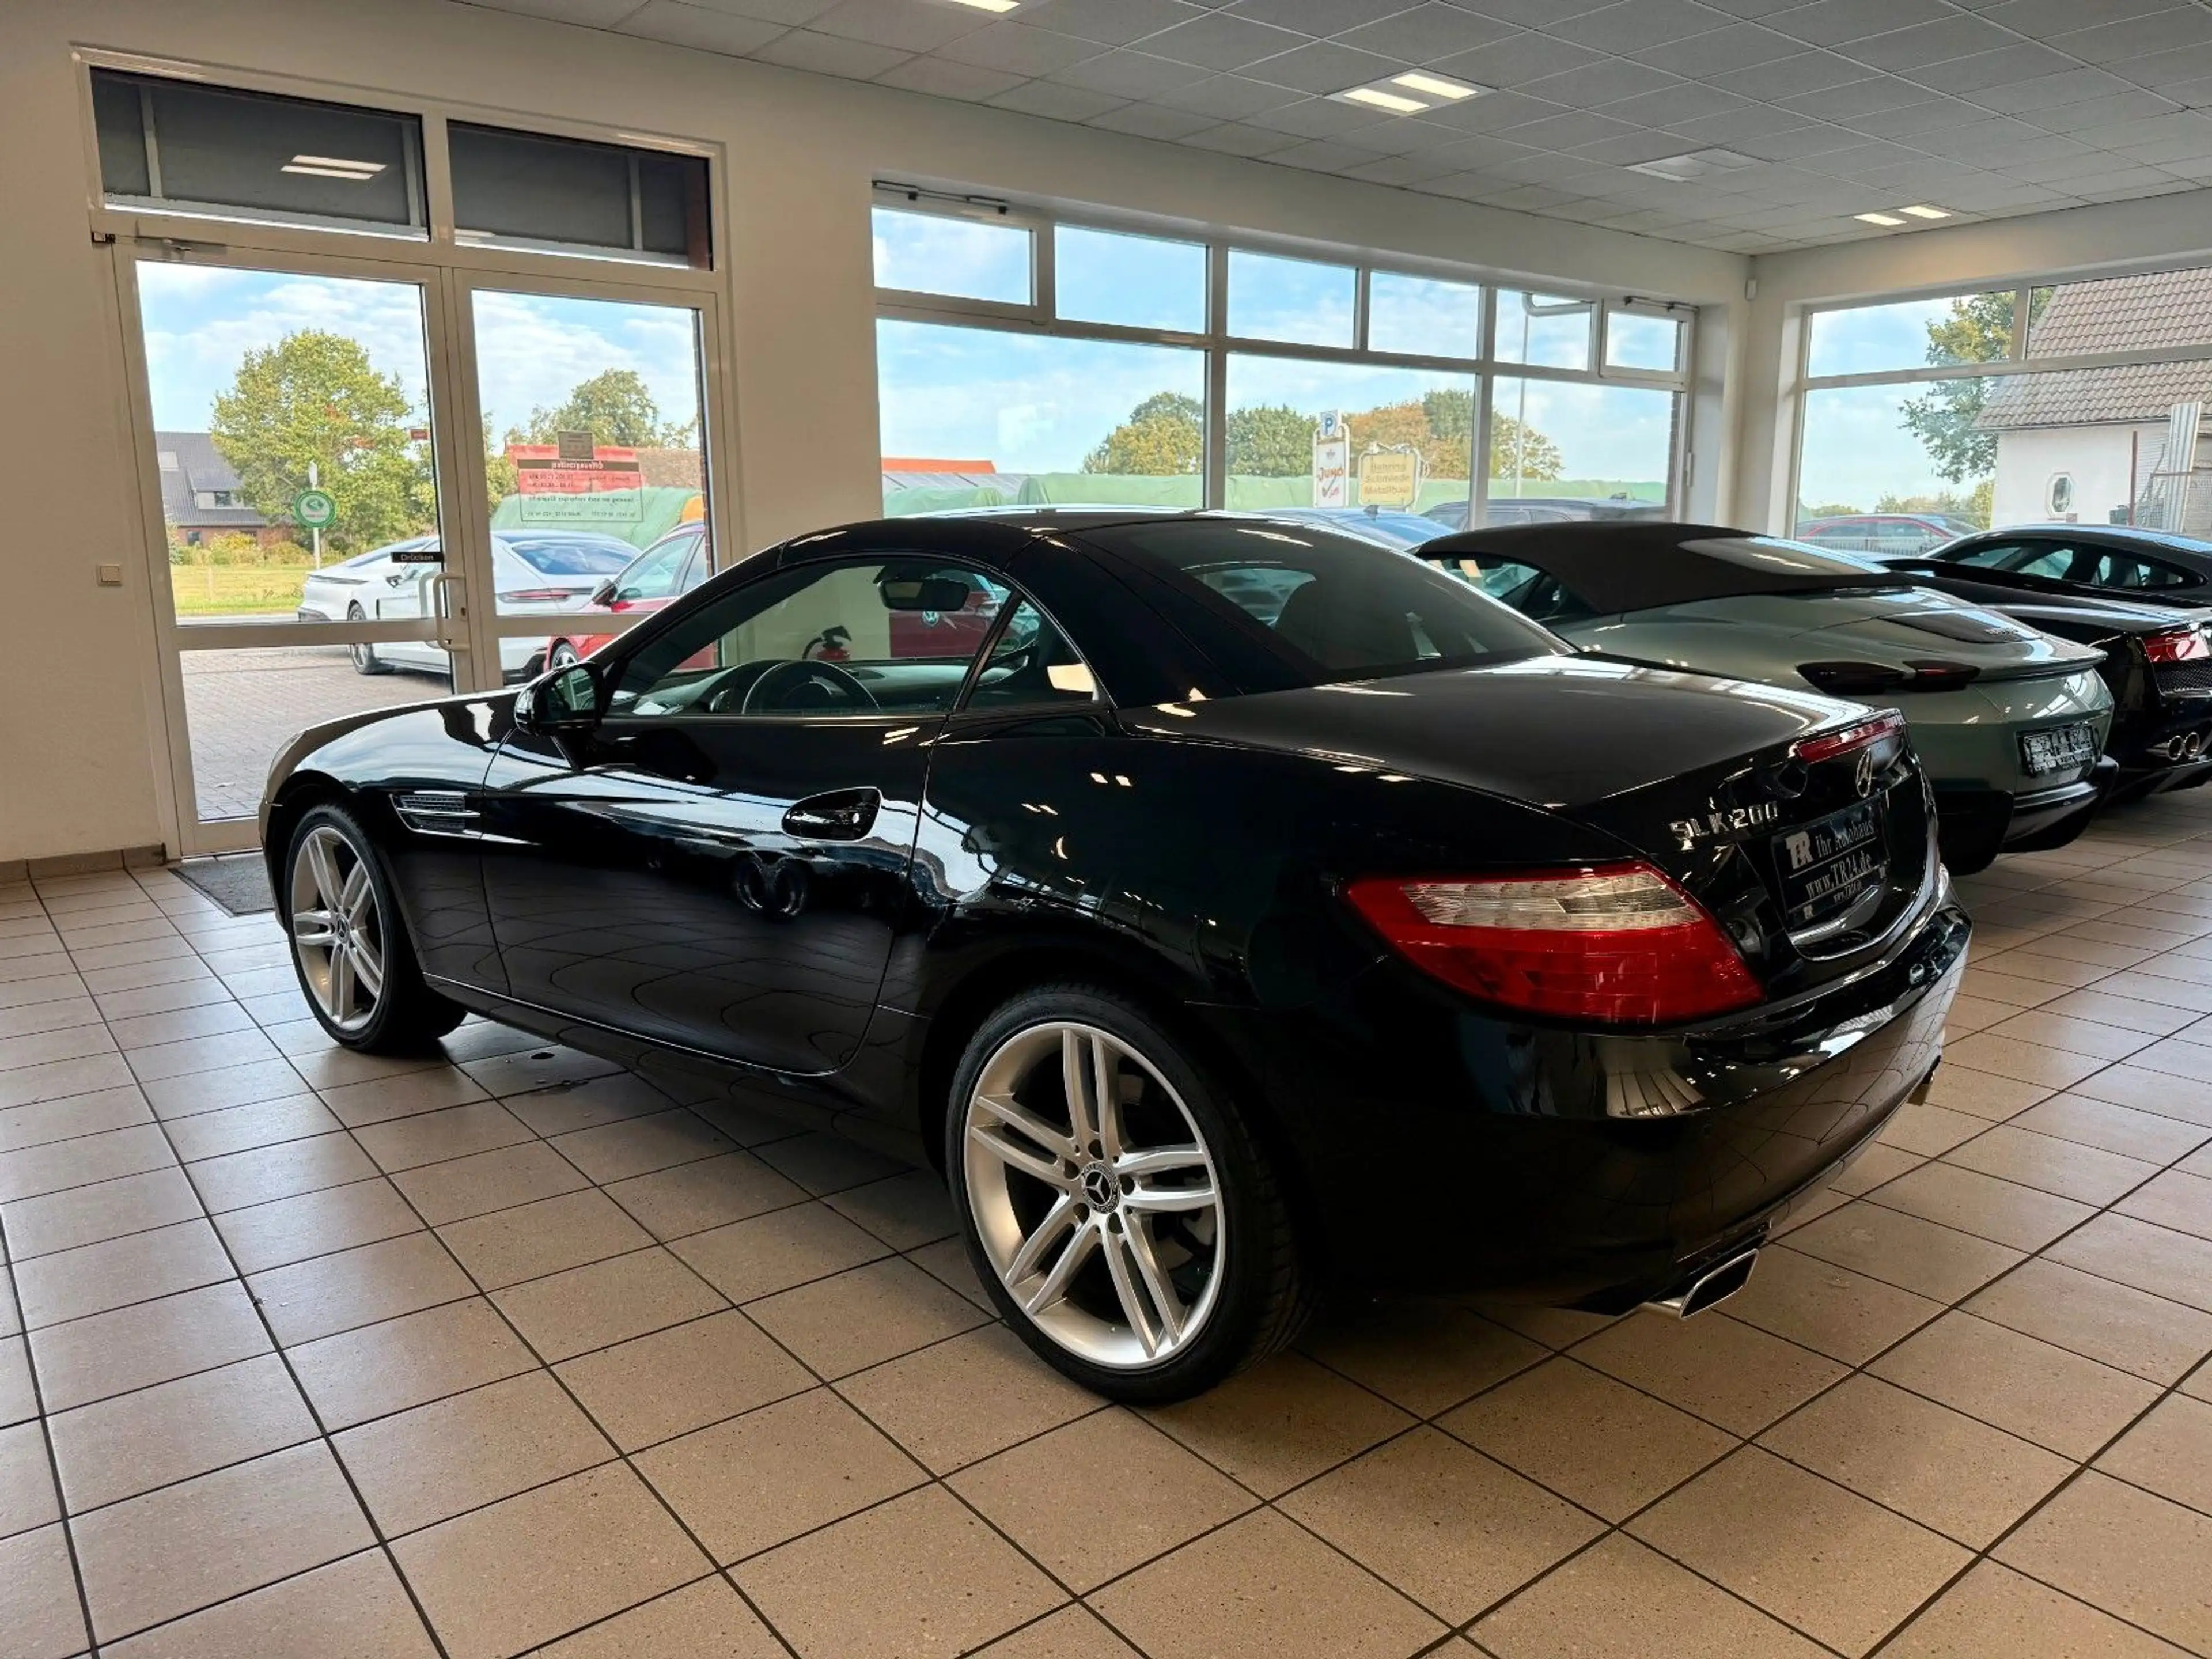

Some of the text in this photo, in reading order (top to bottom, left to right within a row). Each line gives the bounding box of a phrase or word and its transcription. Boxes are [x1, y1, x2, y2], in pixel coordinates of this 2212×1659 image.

[1325, 417, 1334, 434] P
[1669, 800, 1779, 840] SLK 200
[1785, 831, 1813, 869] TR
[1805, 850, 1872, 900] www.TR24.de
